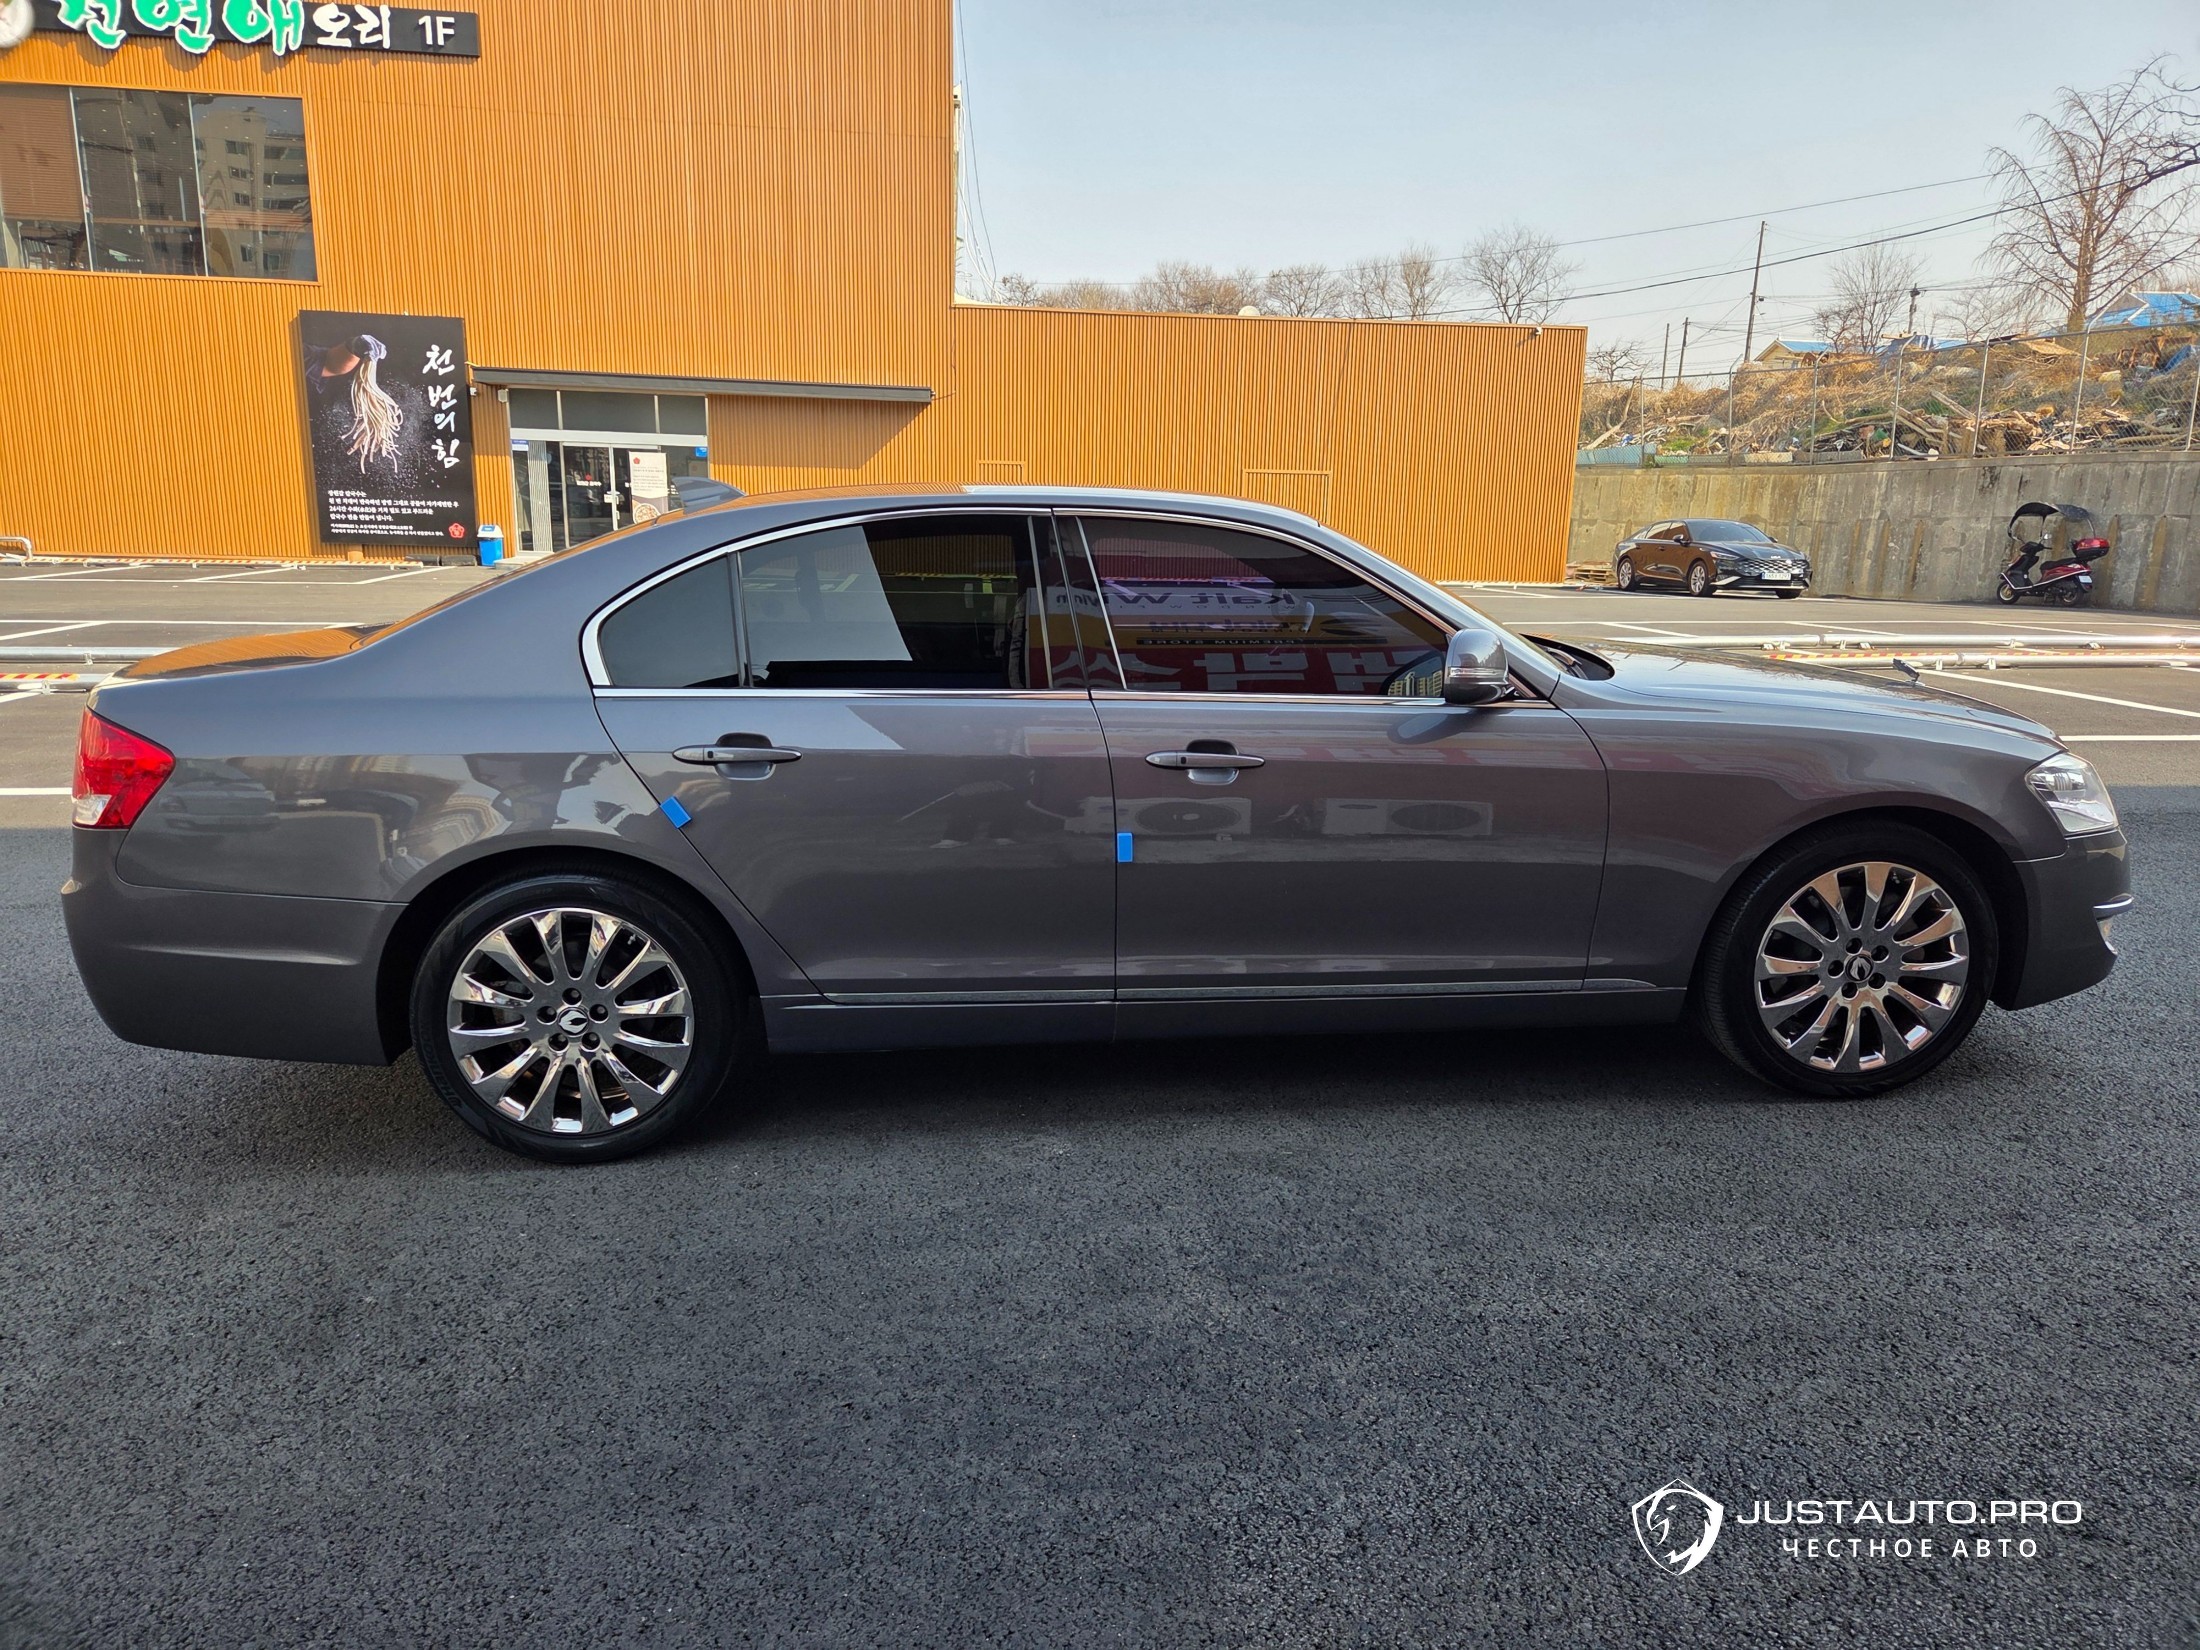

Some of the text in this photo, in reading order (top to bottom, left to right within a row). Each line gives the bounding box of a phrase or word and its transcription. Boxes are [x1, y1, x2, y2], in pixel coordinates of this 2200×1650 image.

[418, 15, 455, 46] 1F
[422, 344, 455, 376] 천
[431, 439, 460, 469] 힘
